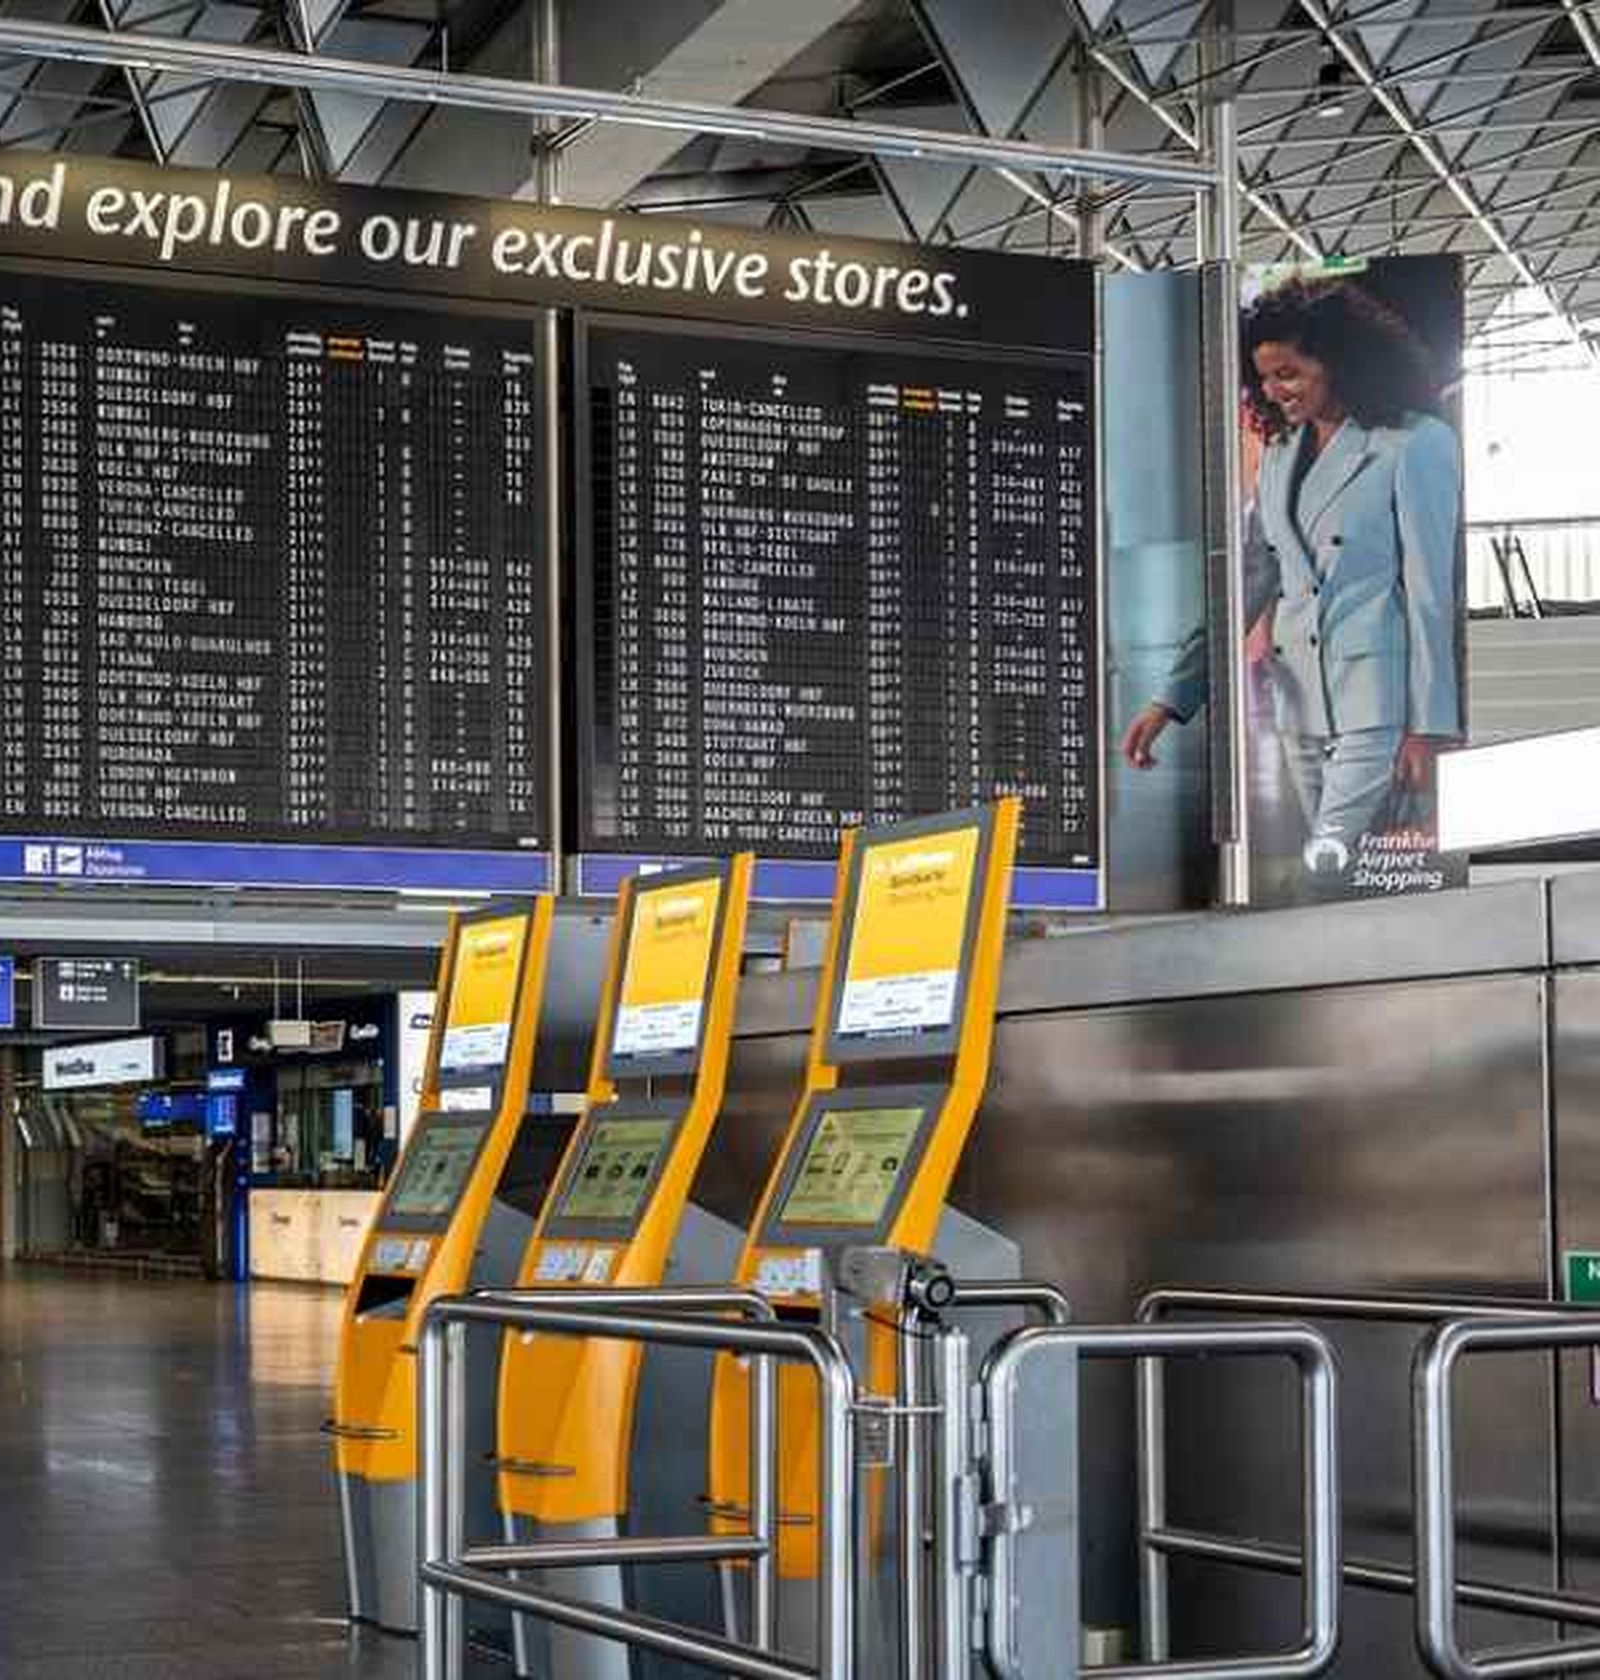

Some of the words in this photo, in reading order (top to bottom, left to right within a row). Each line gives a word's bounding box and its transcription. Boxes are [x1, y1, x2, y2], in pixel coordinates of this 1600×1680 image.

[87, 181, 339, 259] explore
[362, 217, 472, 266] our
[493, 220, 768, 296] exclusive
[784, 249, 969, 318] stores.
[1357, 832, 1436, 849] Frankfu
[1357, 851, 1425, 870] Airport
[1351, 869, 1443, 891] Shopping
